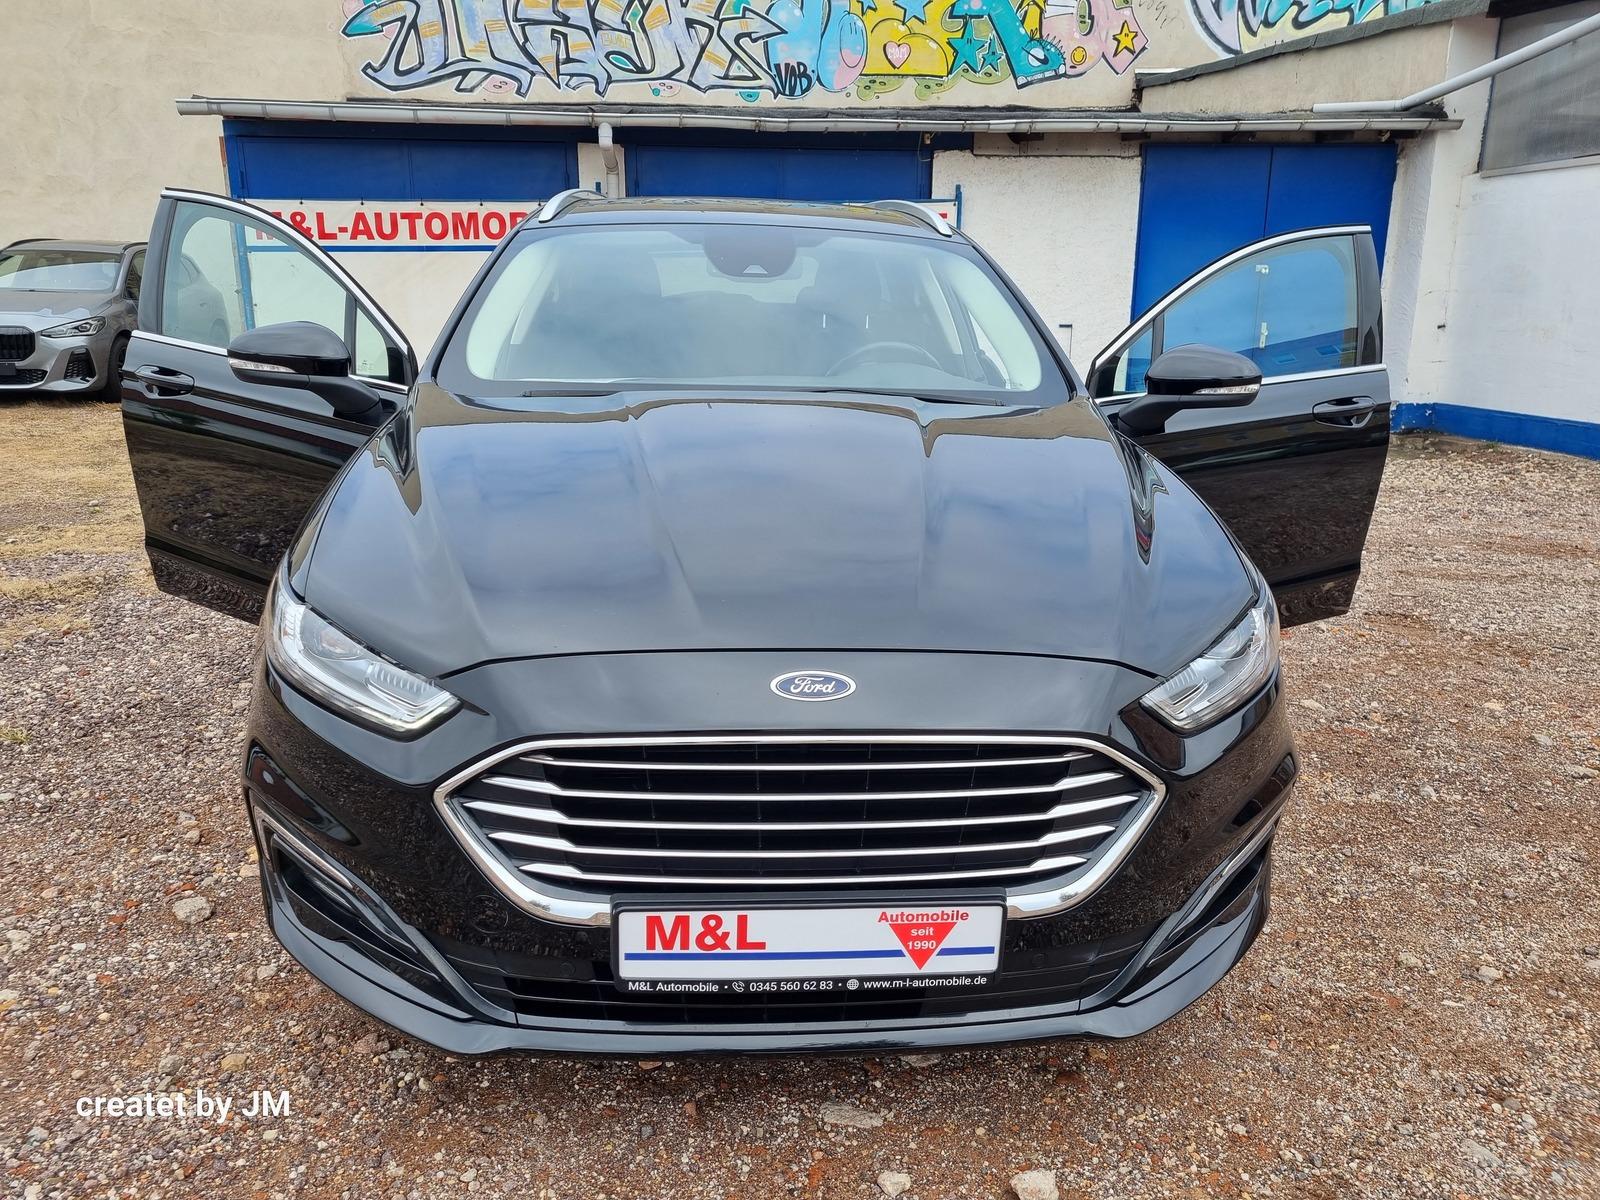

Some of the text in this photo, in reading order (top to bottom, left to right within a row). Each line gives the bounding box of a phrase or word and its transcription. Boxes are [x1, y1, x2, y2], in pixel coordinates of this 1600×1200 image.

[790, 676, 836, 693] Ford
[877, 909, 970, 923] Automobile
[645, 913, 767, 952] M&L
[910, 926, 935, 937] seit
[907, 940, 937, 951] 1990
[628, 975, 988, 992] M&L Automobile 0345 560 62 83 www.m-l-automobile.de
